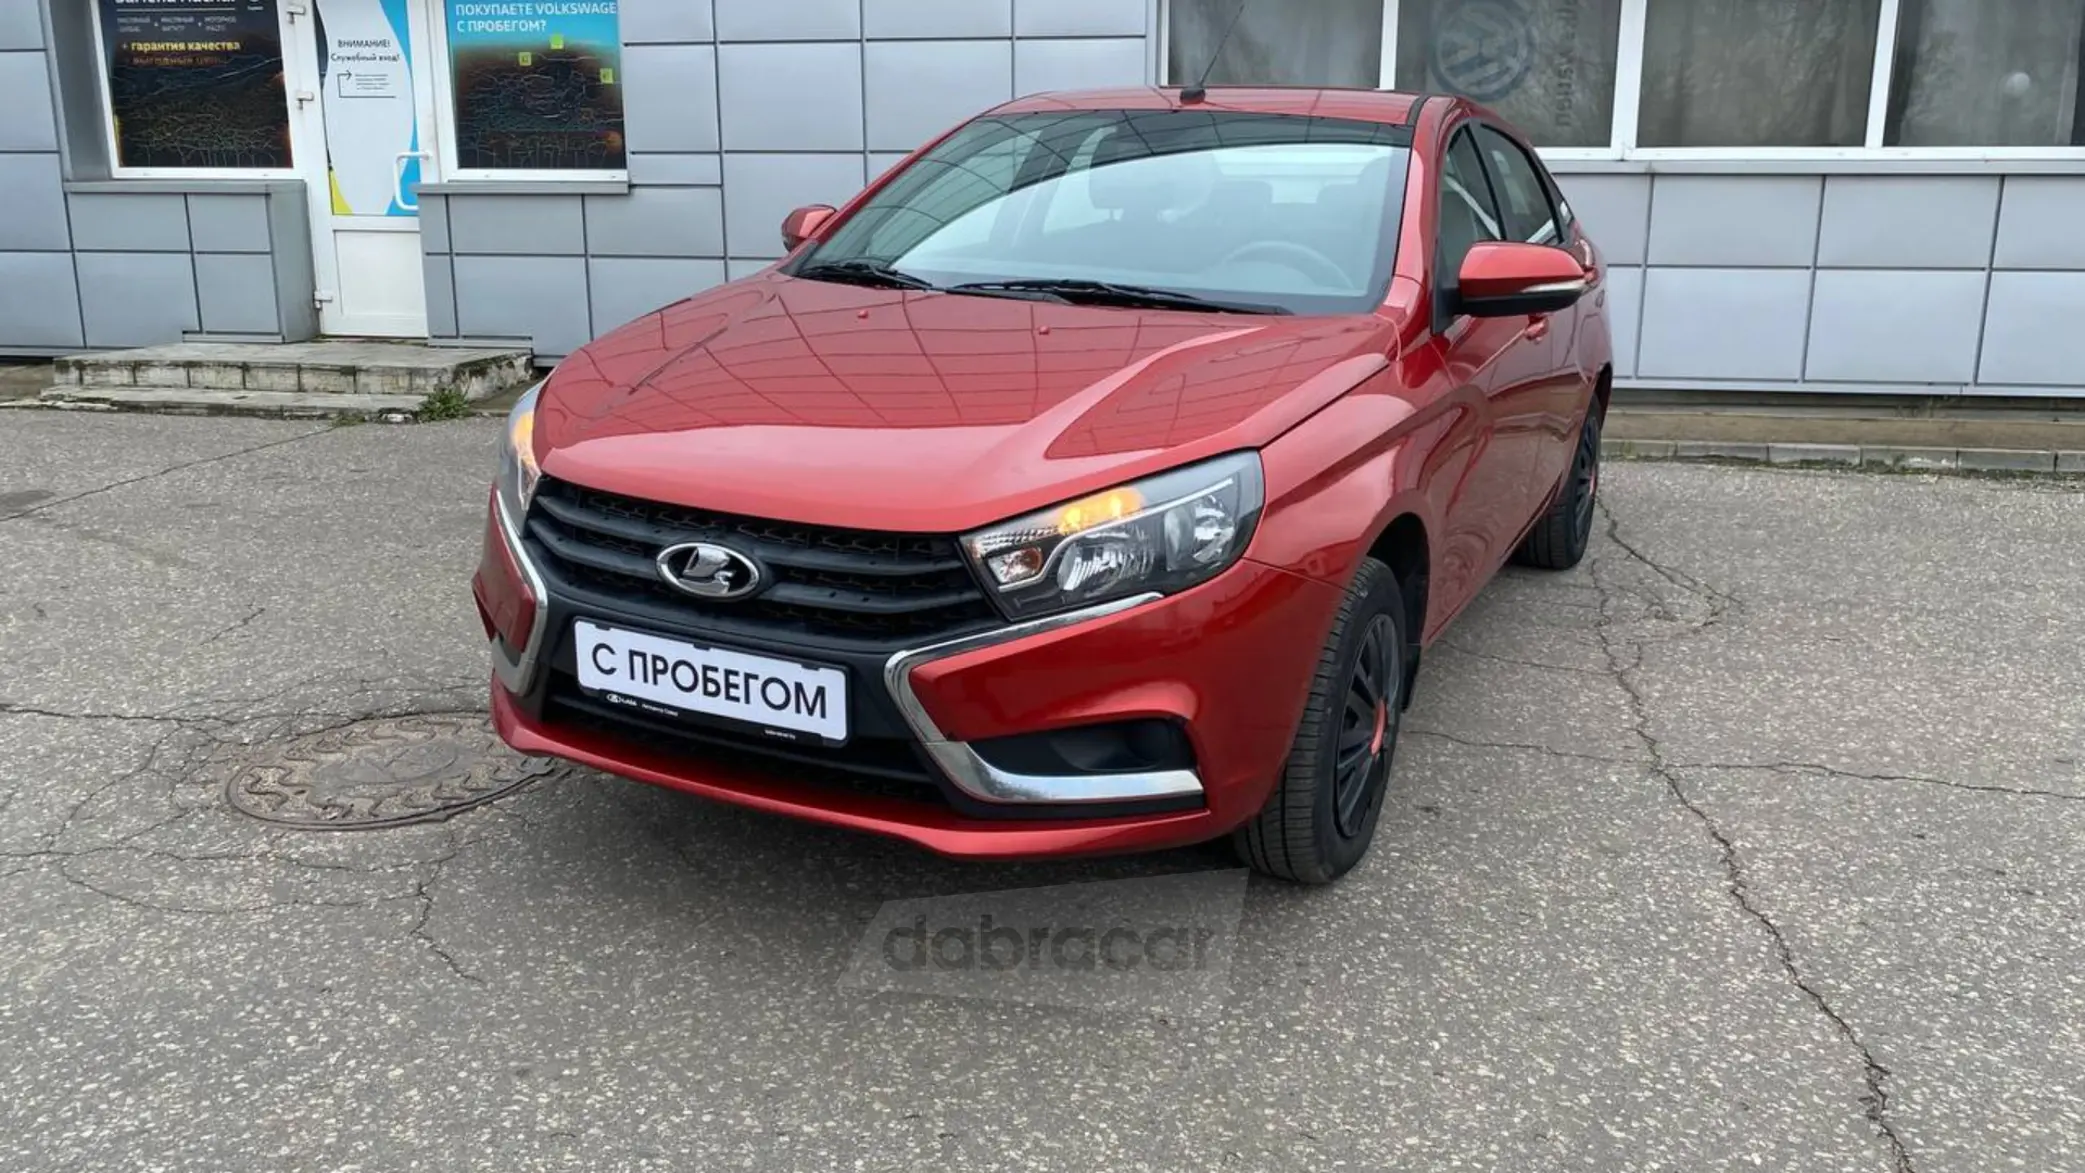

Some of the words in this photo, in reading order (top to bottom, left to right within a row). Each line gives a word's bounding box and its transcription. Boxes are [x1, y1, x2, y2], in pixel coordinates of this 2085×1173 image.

[455, 3, 533, 16] ПОКУПАЕТЕ
[457, 20, 465, 32] С
[467, 20, 547, 32] ПРОБЕГОМ?
[131, 41, 187, 53] гарантия
[187, 41, 241, 51] качества
[337, 39, 391, 48] ВНИМАНИЕ!
[330, 52, 378, 64] Служебный
[592, 643, 617, 676] С
[628, 648, 828, 720] ПРОБЕГОМ
